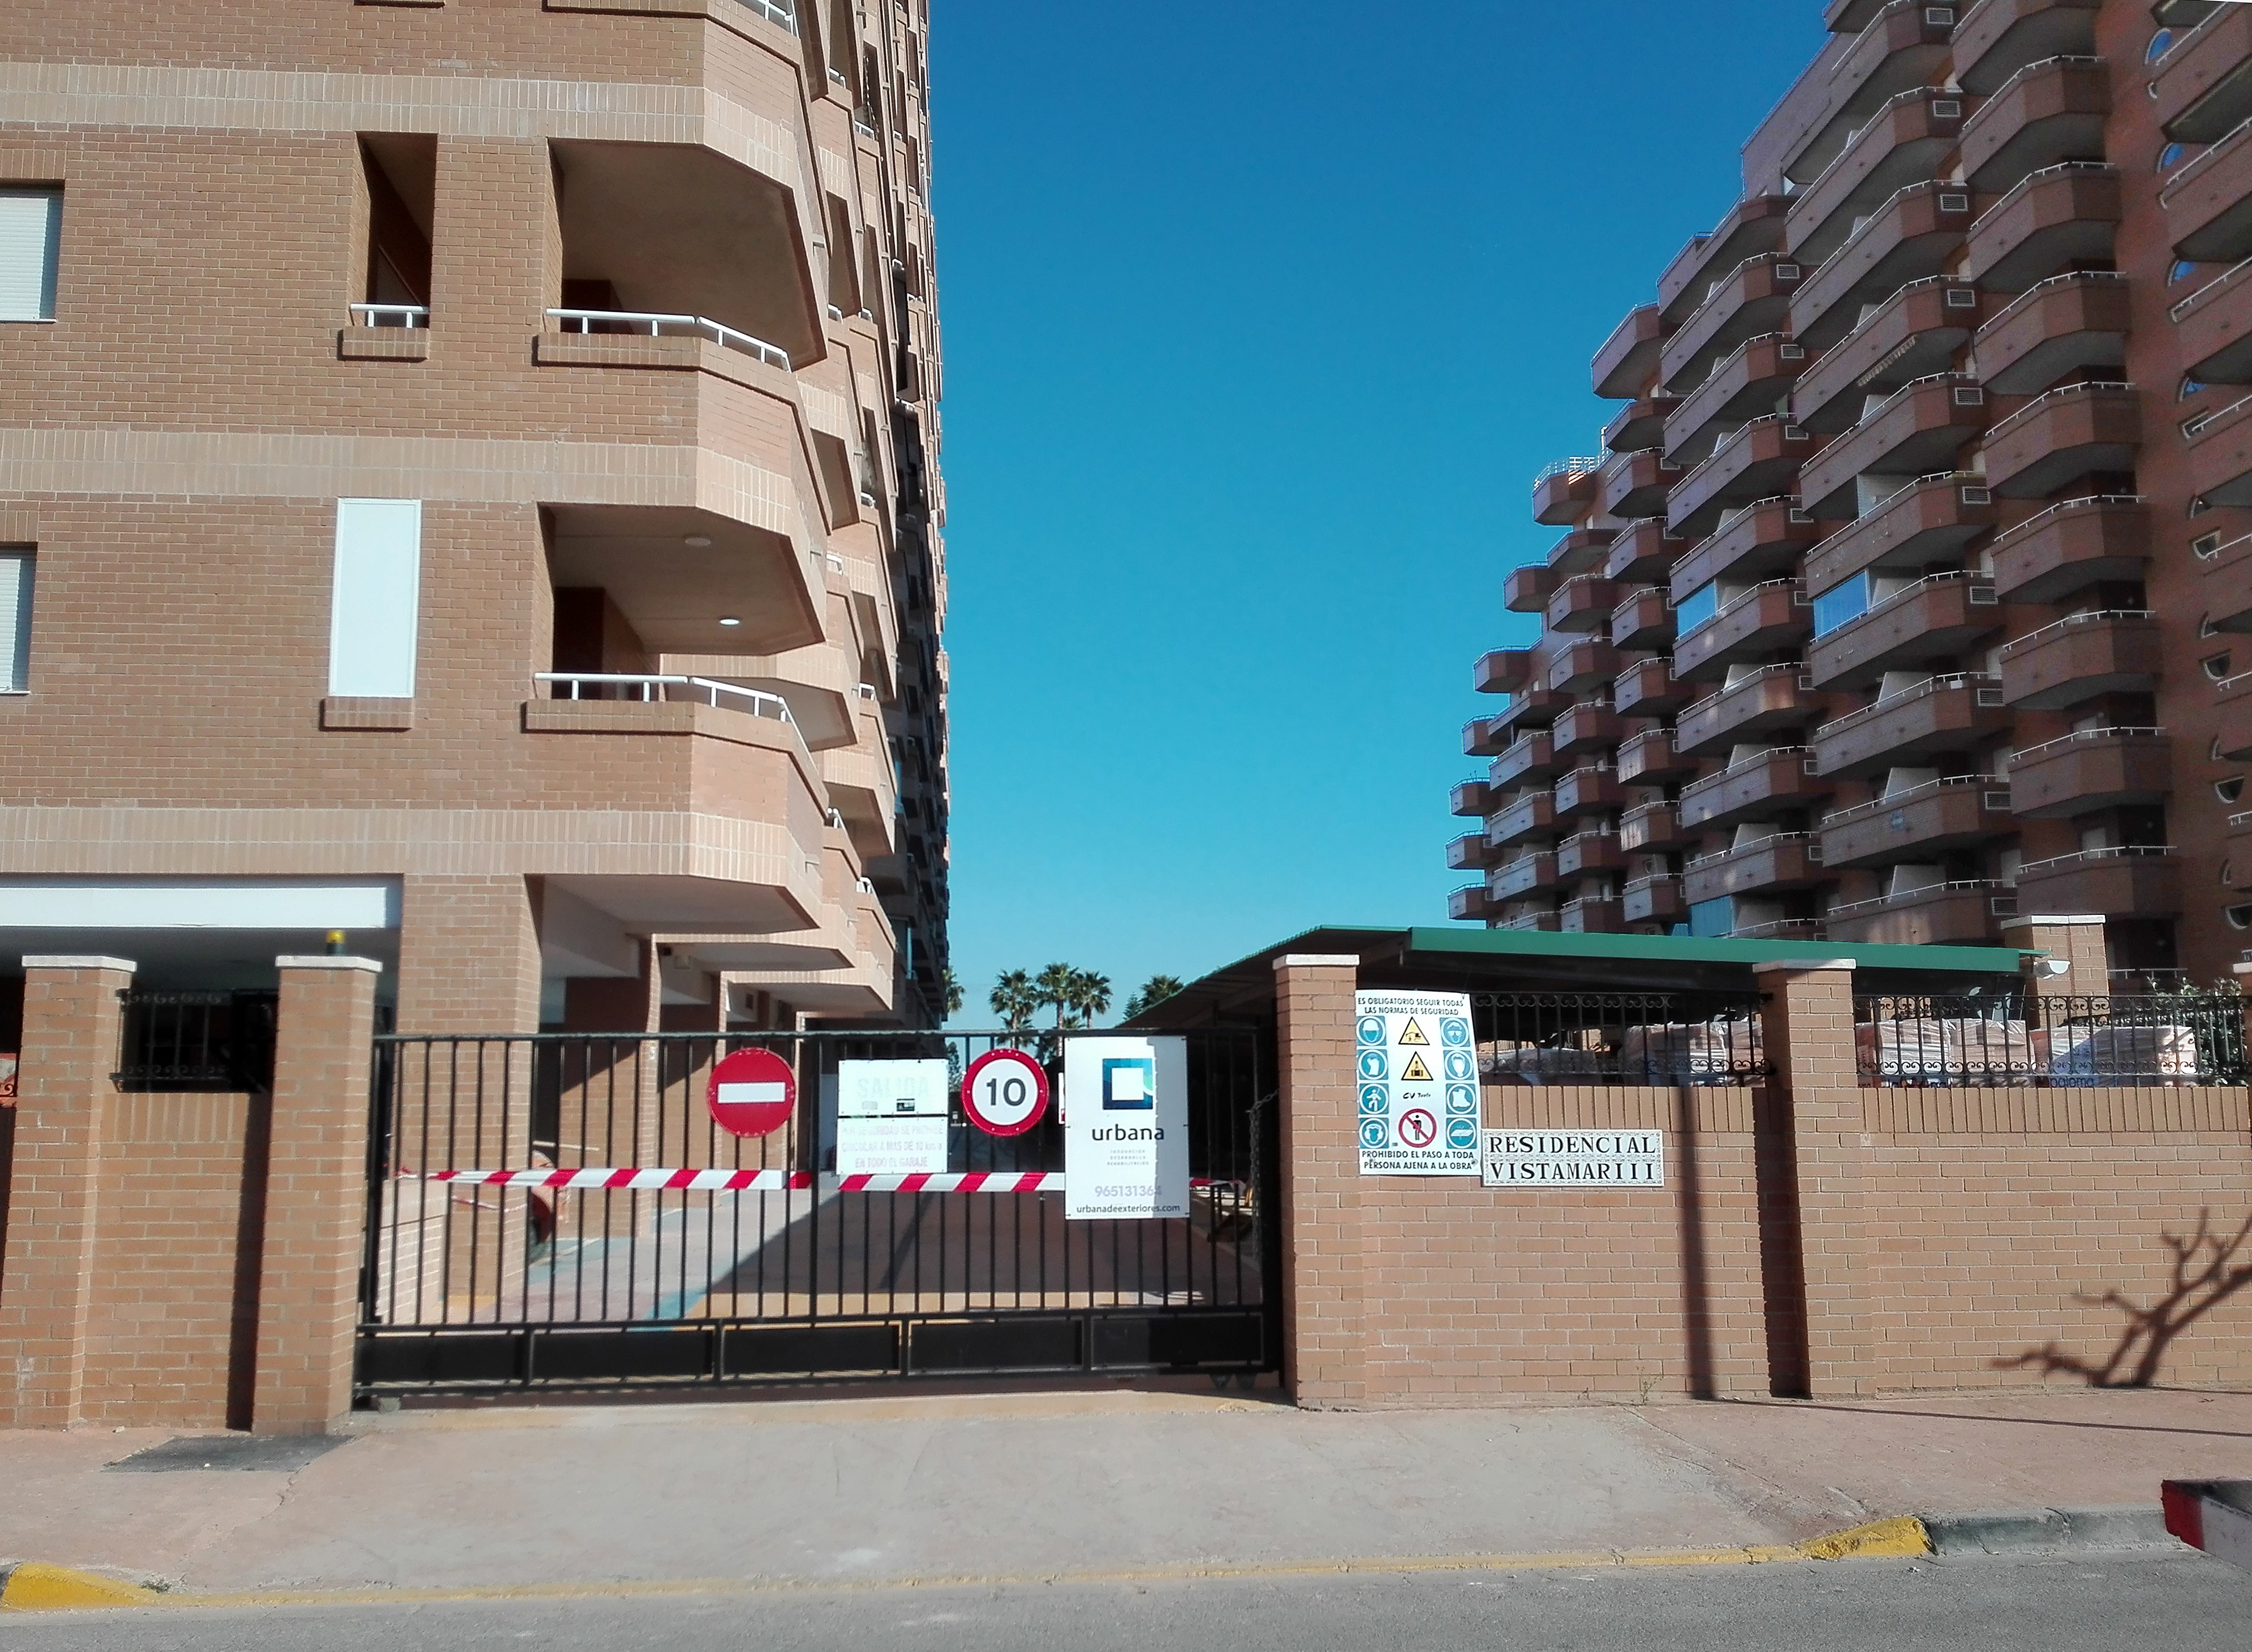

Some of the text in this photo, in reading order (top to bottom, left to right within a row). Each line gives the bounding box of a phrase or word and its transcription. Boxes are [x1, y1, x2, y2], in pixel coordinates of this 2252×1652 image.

[858, 1077, 929, 1098] SALIDA
[986, 1078, 1026, 1106] 10
[1091, 1124, 1165, 1141] urbana
[1489, 1136, 1656, 1154] RESIDENCIAL
[1077, 1204, 1180, 1213] urbanadeexteriores.com
